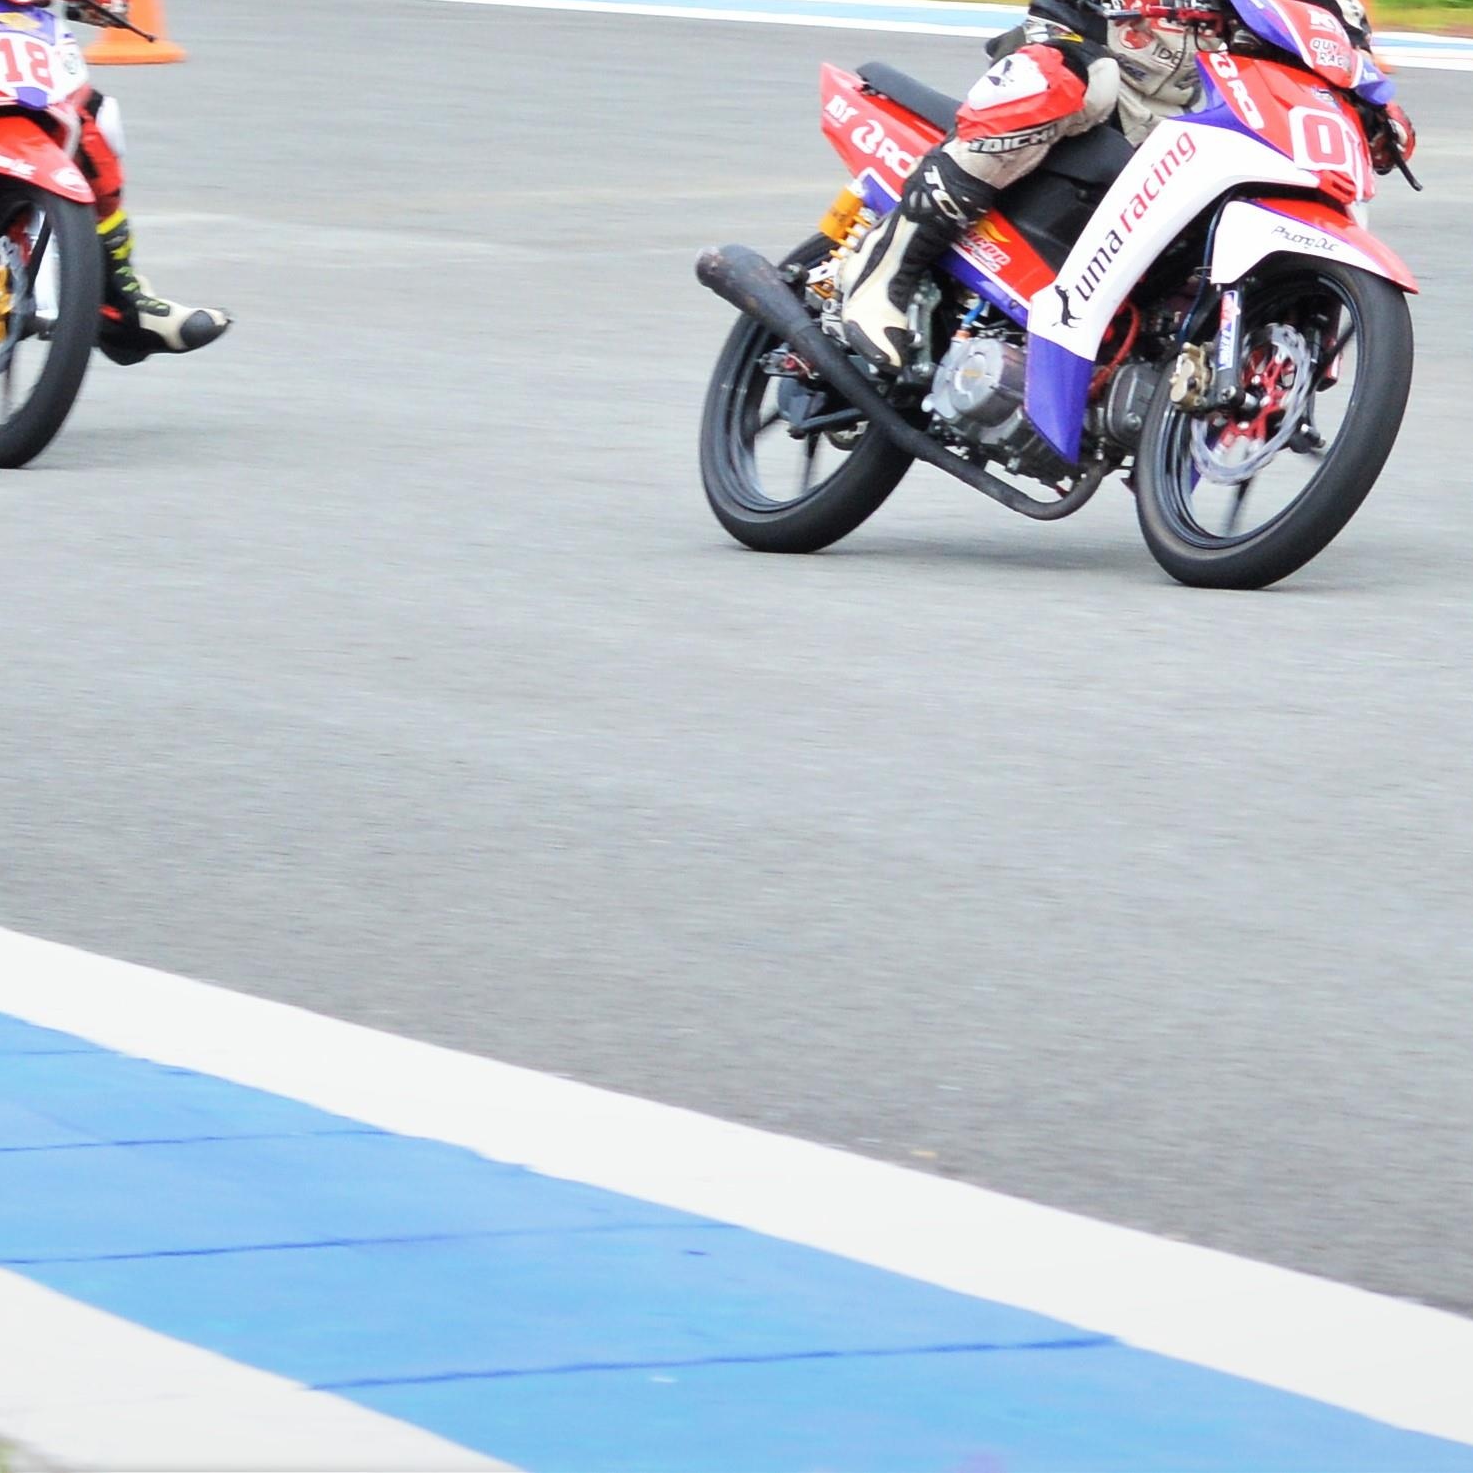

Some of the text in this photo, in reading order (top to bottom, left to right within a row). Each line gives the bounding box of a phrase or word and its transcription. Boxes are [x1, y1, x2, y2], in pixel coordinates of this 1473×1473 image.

[968, 123, 1057, 154] TAICHI
[1075, 230, 1125, 302] uma
[1119, 131, 1198, 235] racing
